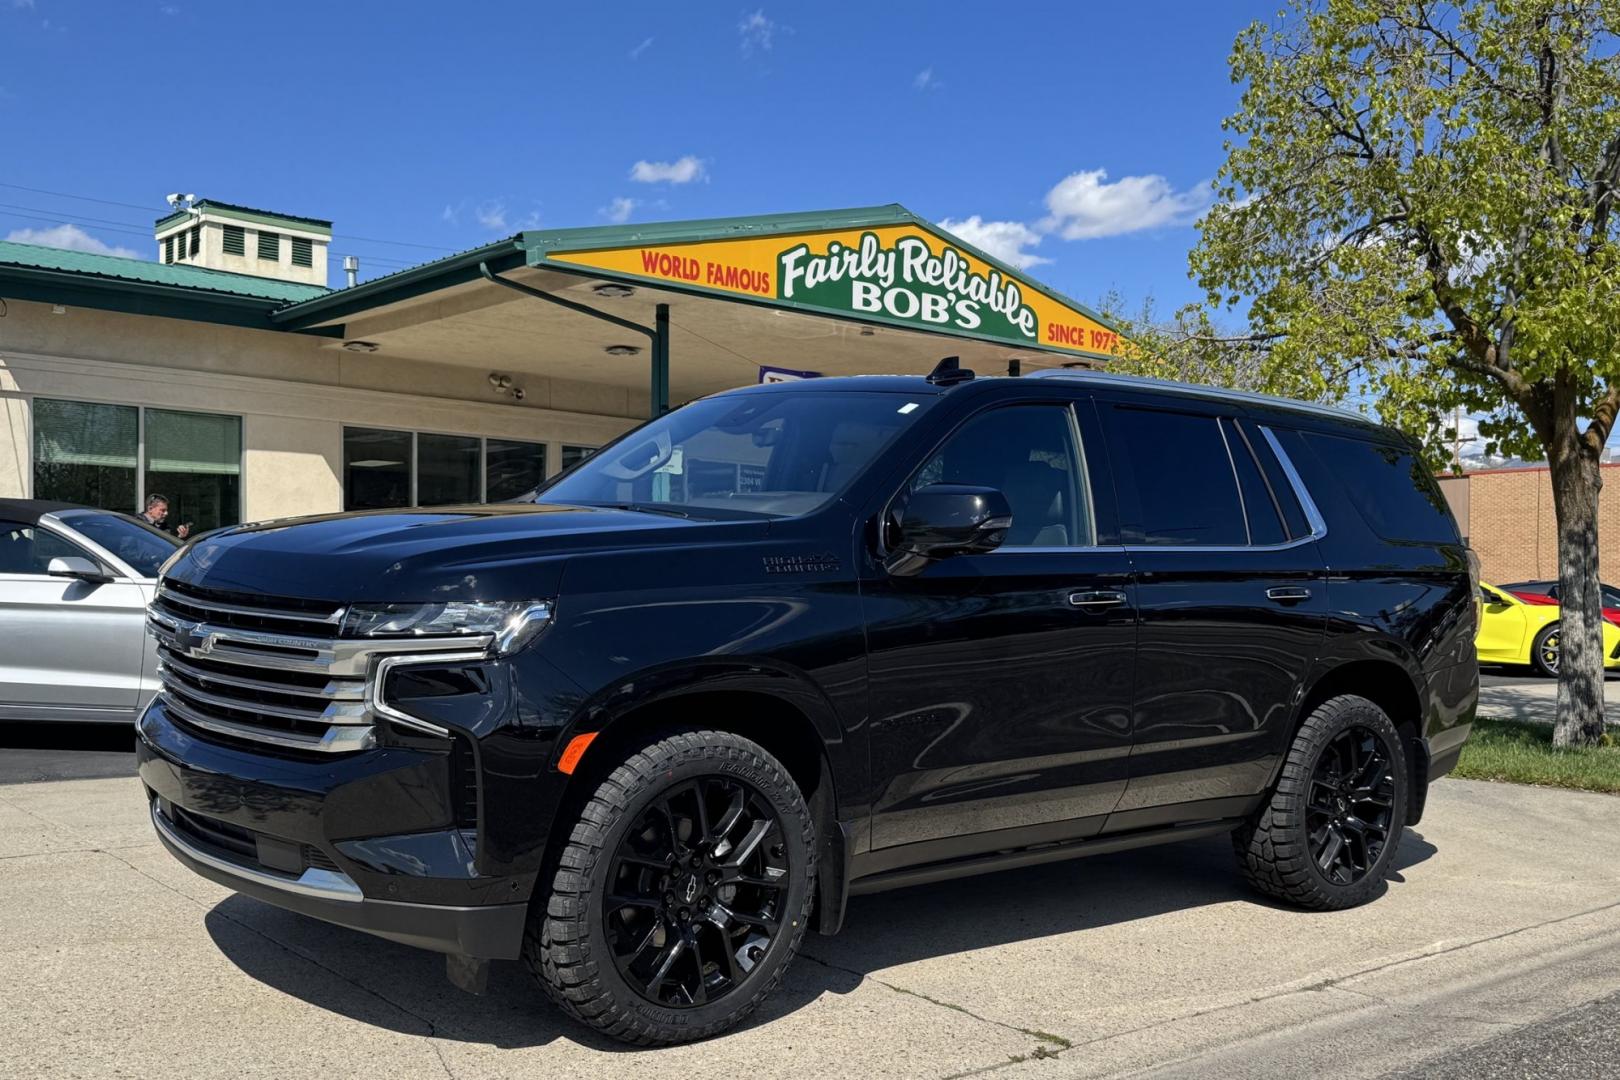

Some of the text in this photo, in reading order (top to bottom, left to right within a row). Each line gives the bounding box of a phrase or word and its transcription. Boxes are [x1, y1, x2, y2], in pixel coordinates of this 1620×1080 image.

[641, 250, 770, 293] WORLD FAMOUS
[781, 235, 1036, 337] Fairly Reliable
[852, 280, 982, 329] BOB'S
[1048, 323, 1084, 346] SINCE
